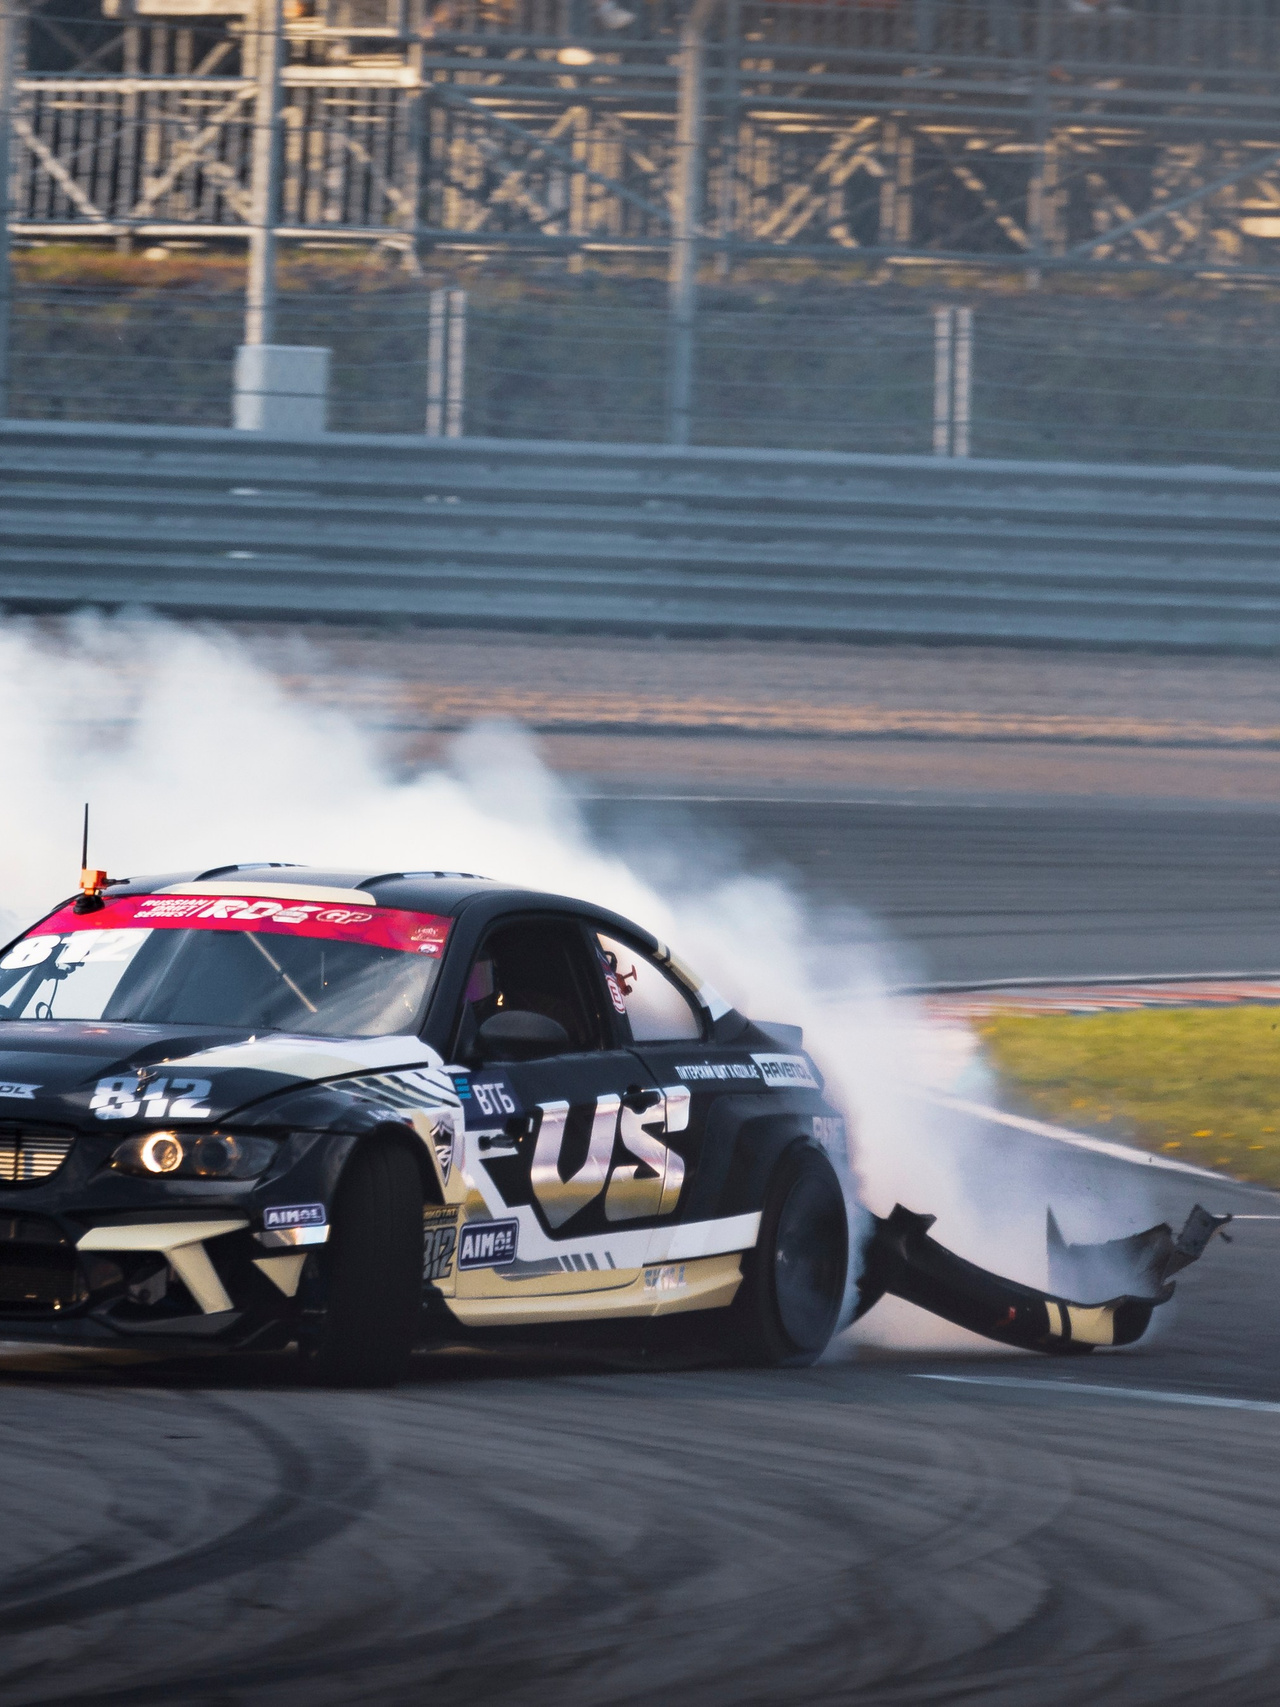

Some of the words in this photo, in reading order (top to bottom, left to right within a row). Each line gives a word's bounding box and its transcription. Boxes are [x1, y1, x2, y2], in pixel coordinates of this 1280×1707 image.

[133, 910, 188, 918] SERIES
[140, 899, 209, 907] RUSSIAN
[197, 899, 324, 924] RDS
[316, 909, 373, 924] GP
[0, 928, 146, 970] 812
[88, 1075, 213, 1120] 812
[472, 1082, 515, 1115] ВТБ
[267, 1208, 322, 1225] AIMOL
[461, 1230, 515, 1260] AIMOL
